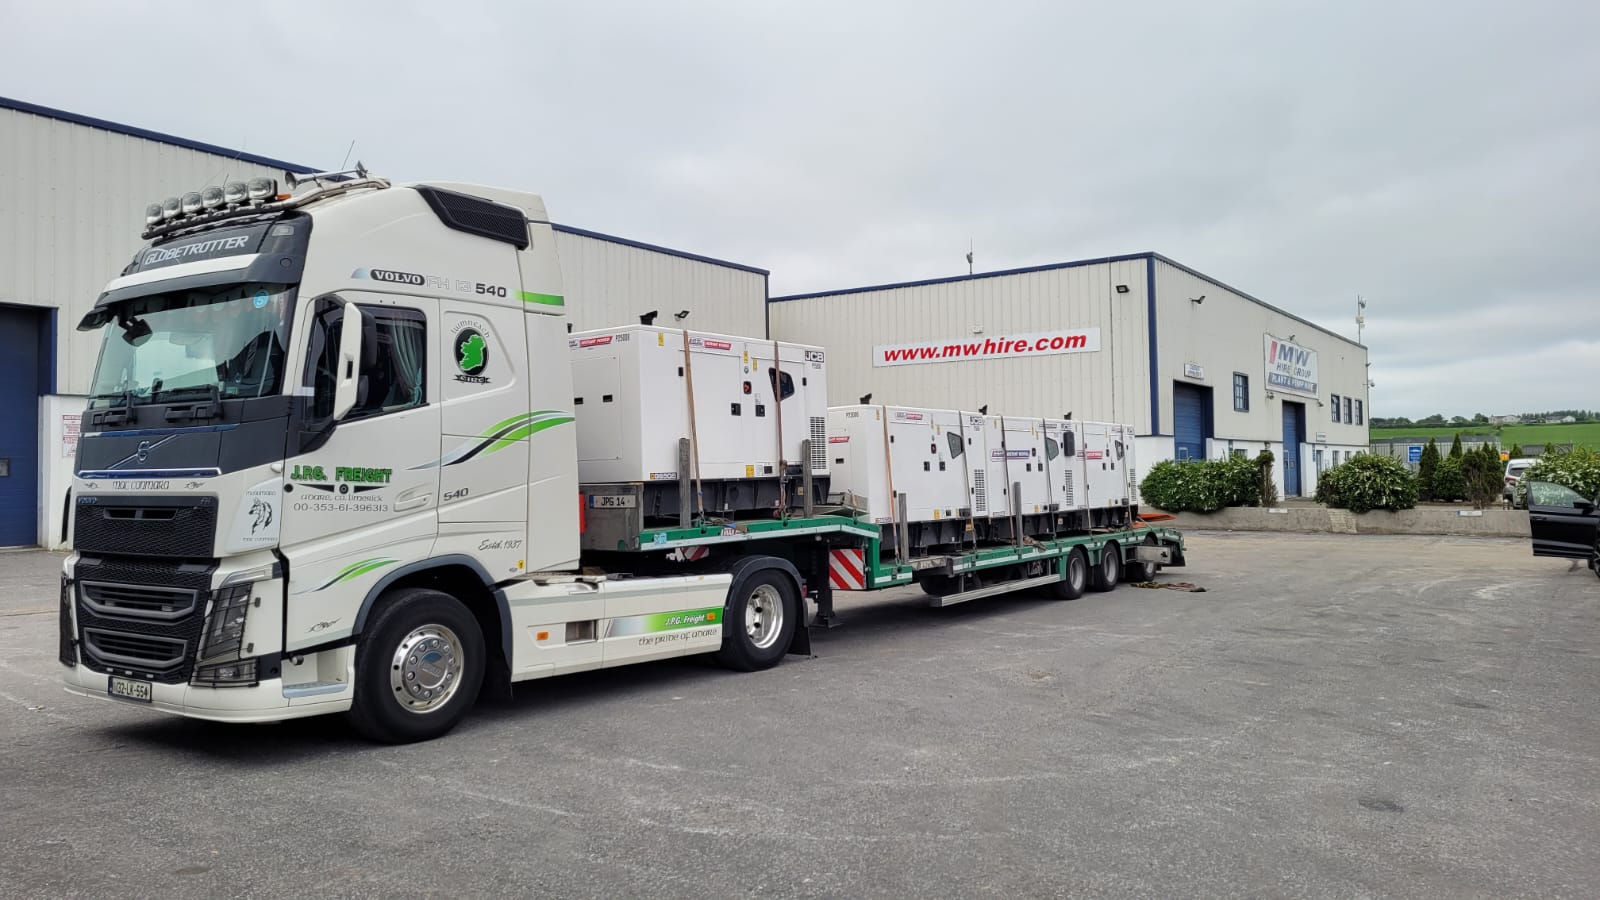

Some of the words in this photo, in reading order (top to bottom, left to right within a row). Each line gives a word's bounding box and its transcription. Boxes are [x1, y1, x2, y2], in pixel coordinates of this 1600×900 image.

[145, 236, 249, 265] GLOBETROTTER
[374, 270, 421, 285] VOLVO
[426, 275, 449, 290] FH
[475, 283, 507, 298] 540
[884, 334, 1087, 362] www.mwhire.com
[1279, 343, 1311, 367] MW
[805, 350, 824, 363] JCB
[290, 465, 328, 482] J.P.G.
[335, 466, 392, 483] FREIGHT
[443, 487, 469, 501] 540
[601, 496, 614, 506] JPG
[616, 496, 625, 506] 14
[293, 502, 388, 512] 00-353-61-396313
[503, 540, 522, 550] 1937
[665, 617, 682, 626] J.P.G.
[683, 614, 705, 624] Freight
